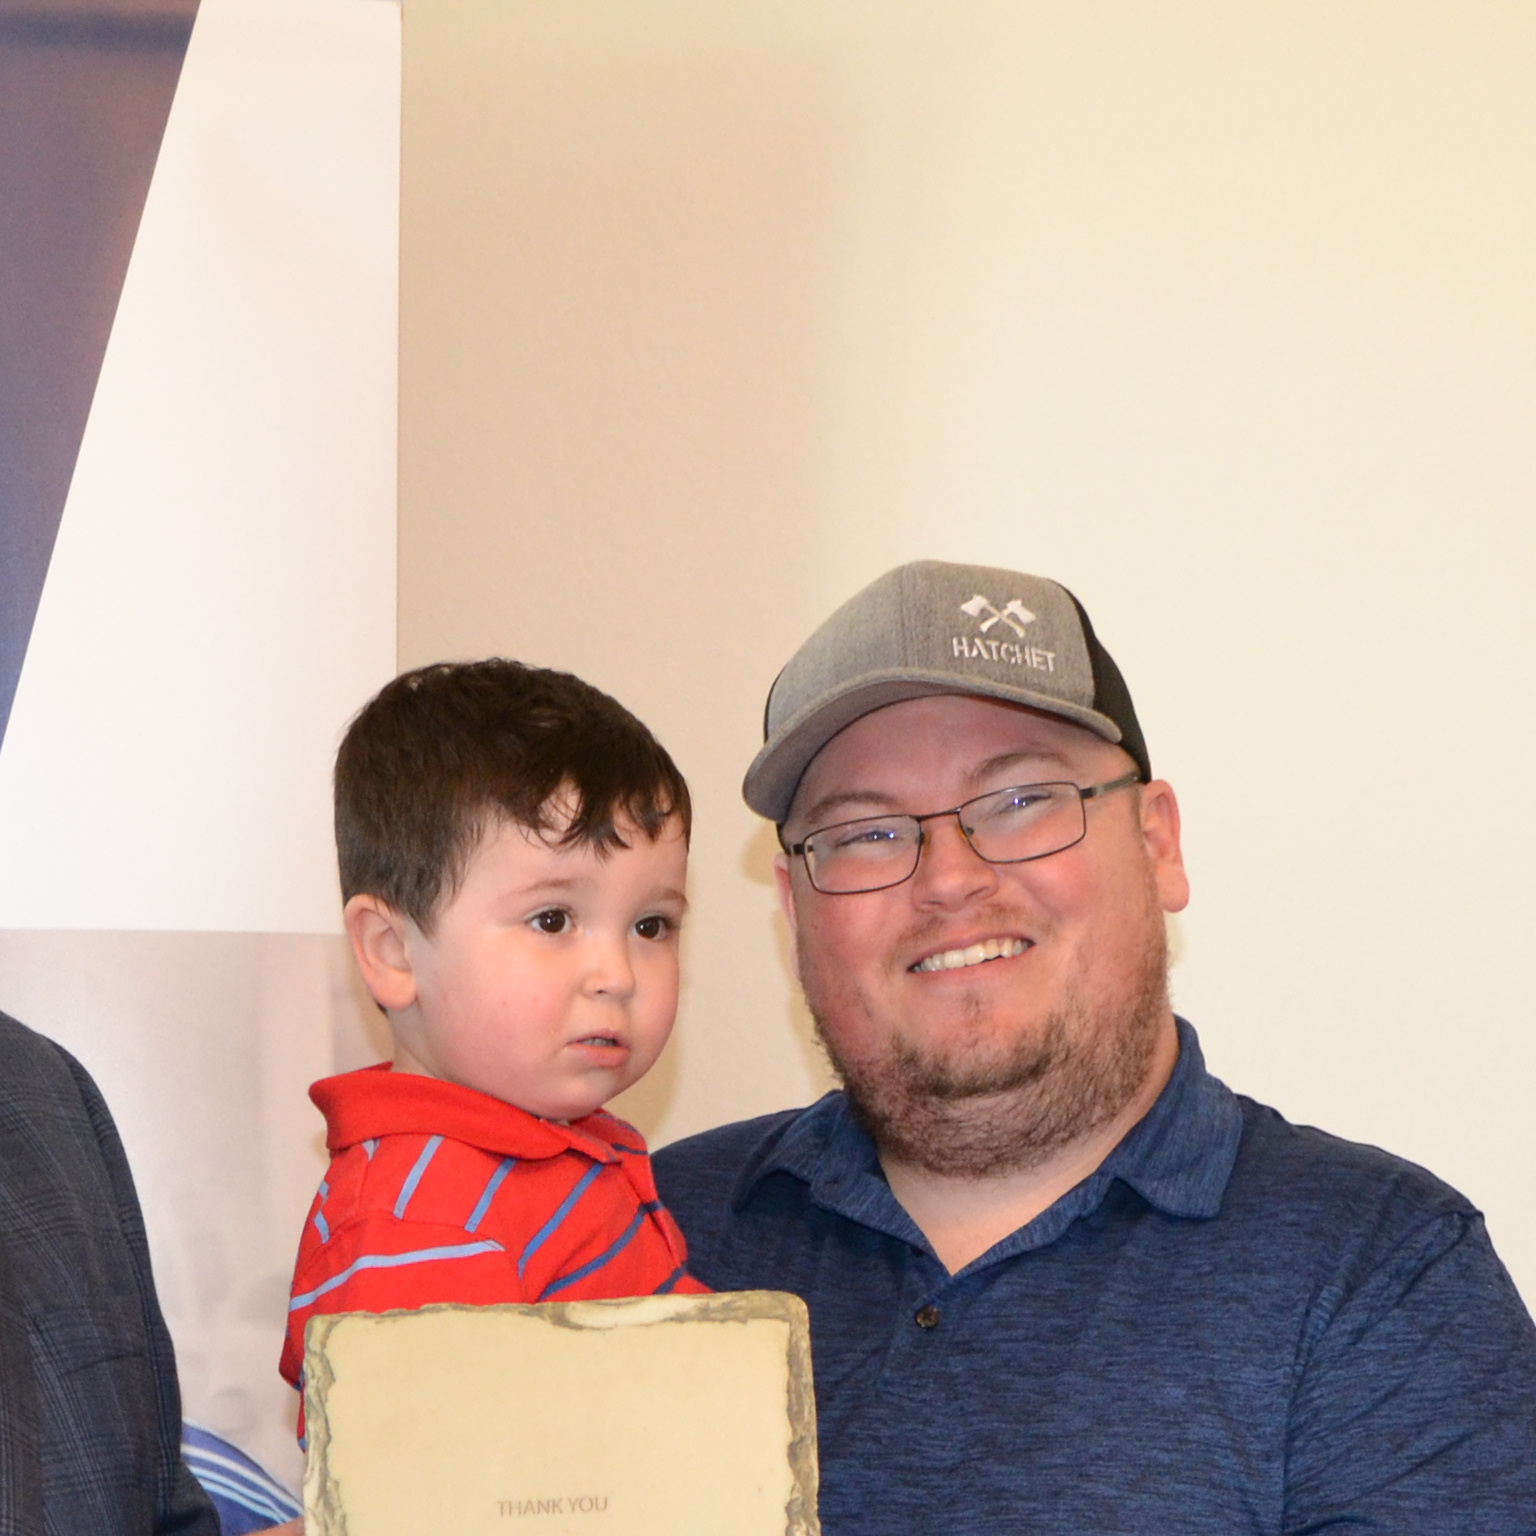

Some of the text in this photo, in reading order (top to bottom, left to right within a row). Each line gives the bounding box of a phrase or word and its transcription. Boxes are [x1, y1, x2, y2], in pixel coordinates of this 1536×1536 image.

[952, 636, 1056, 672] HATCHET
[497, 1496, 608, 1517] THANK YOU
